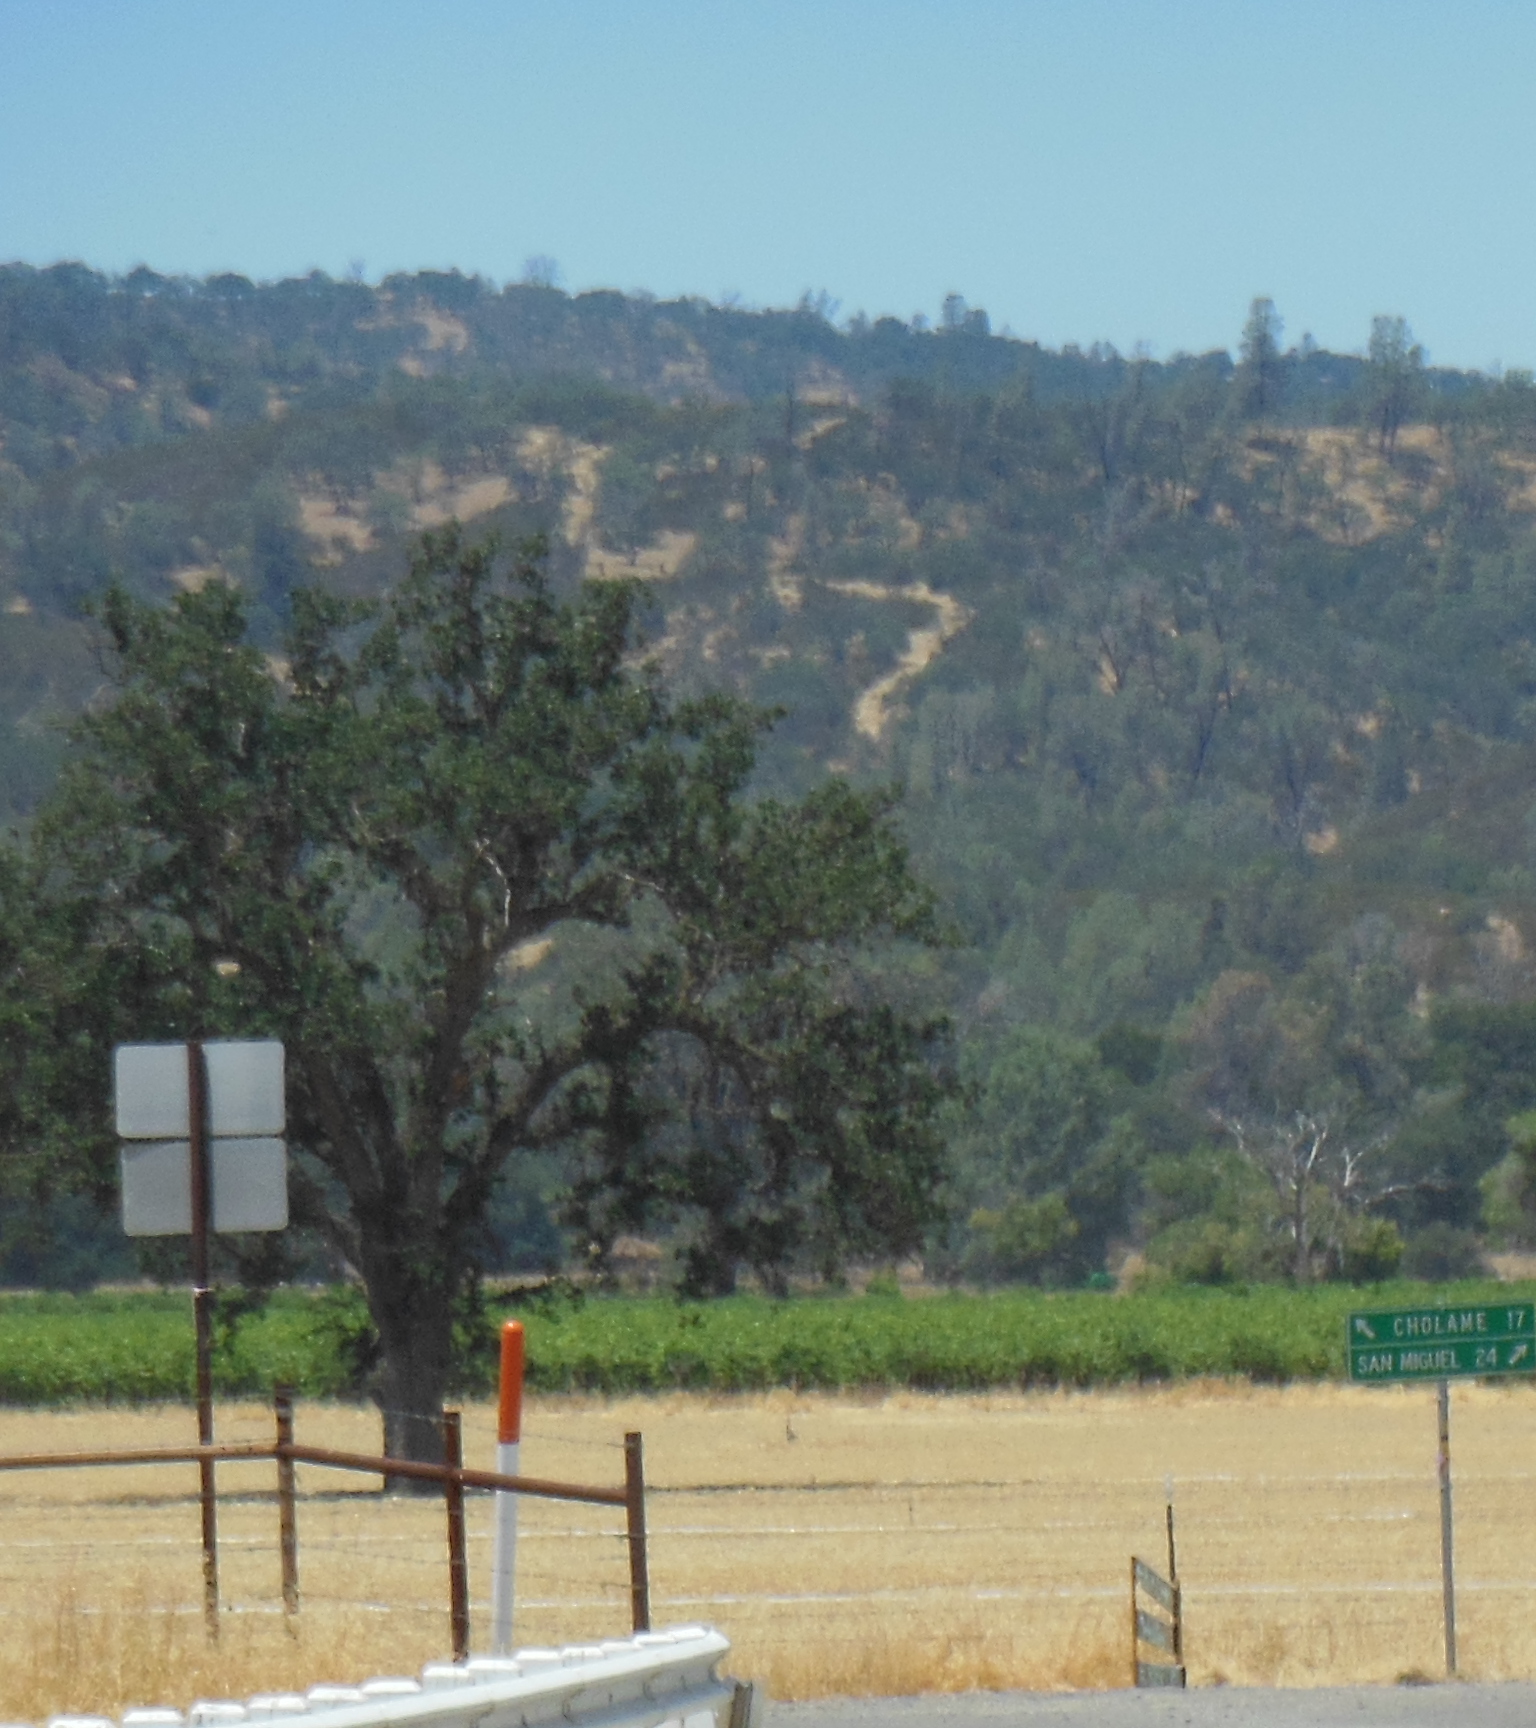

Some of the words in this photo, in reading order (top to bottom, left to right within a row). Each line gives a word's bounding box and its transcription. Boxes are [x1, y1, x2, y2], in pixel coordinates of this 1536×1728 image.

[1393, 1312, 1488, 1337] CHOLAME
[1507, 1310, 1525, 1330] 17
[1358, 1354, 1393, 1374] SAN
[1400, 1350, 1460, 1371] MIGUEL
[1475, 1347, 1498, 1367] 24
